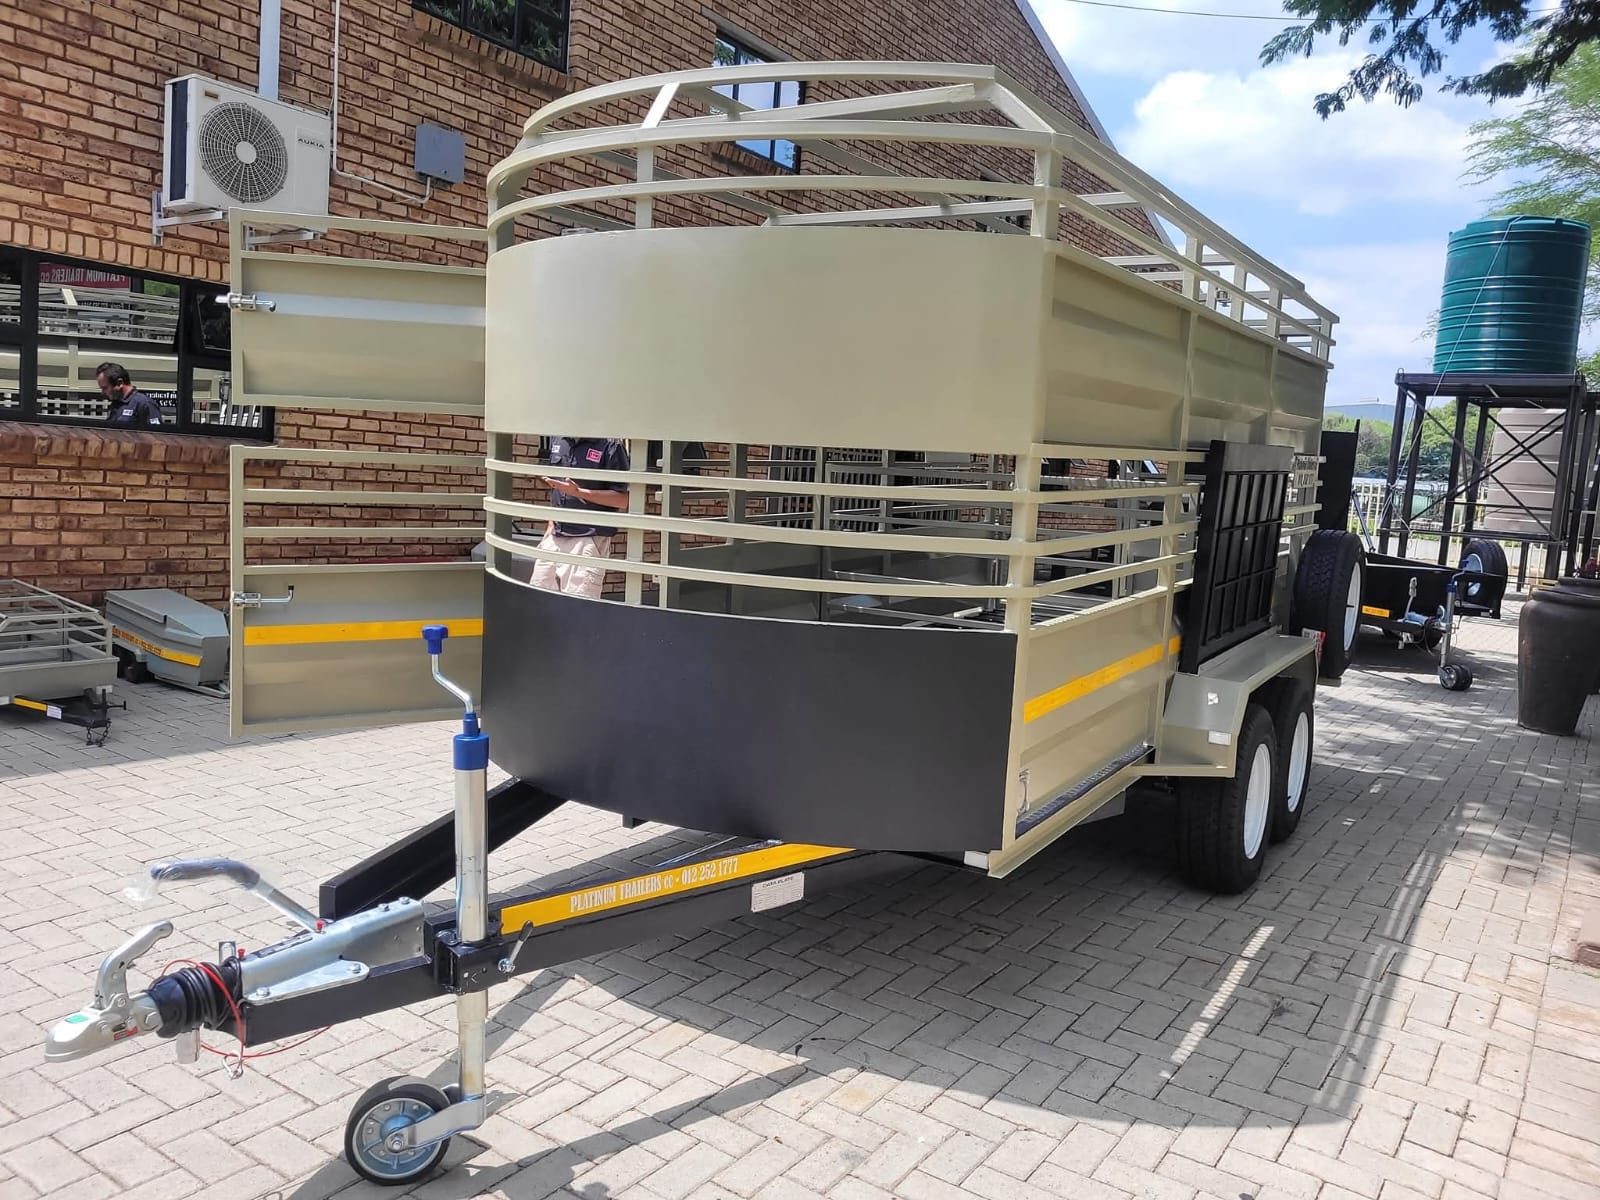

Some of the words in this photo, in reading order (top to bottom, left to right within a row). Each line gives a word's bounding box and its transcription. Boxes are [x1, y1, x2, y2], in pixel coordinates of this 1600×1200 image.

[570, 886, 617, 913] PLATINUM
[620, 874, 661, 900] TRAILERS
[681, 867, 698, 885] 012
[719, 857, 738, 876] 1777
